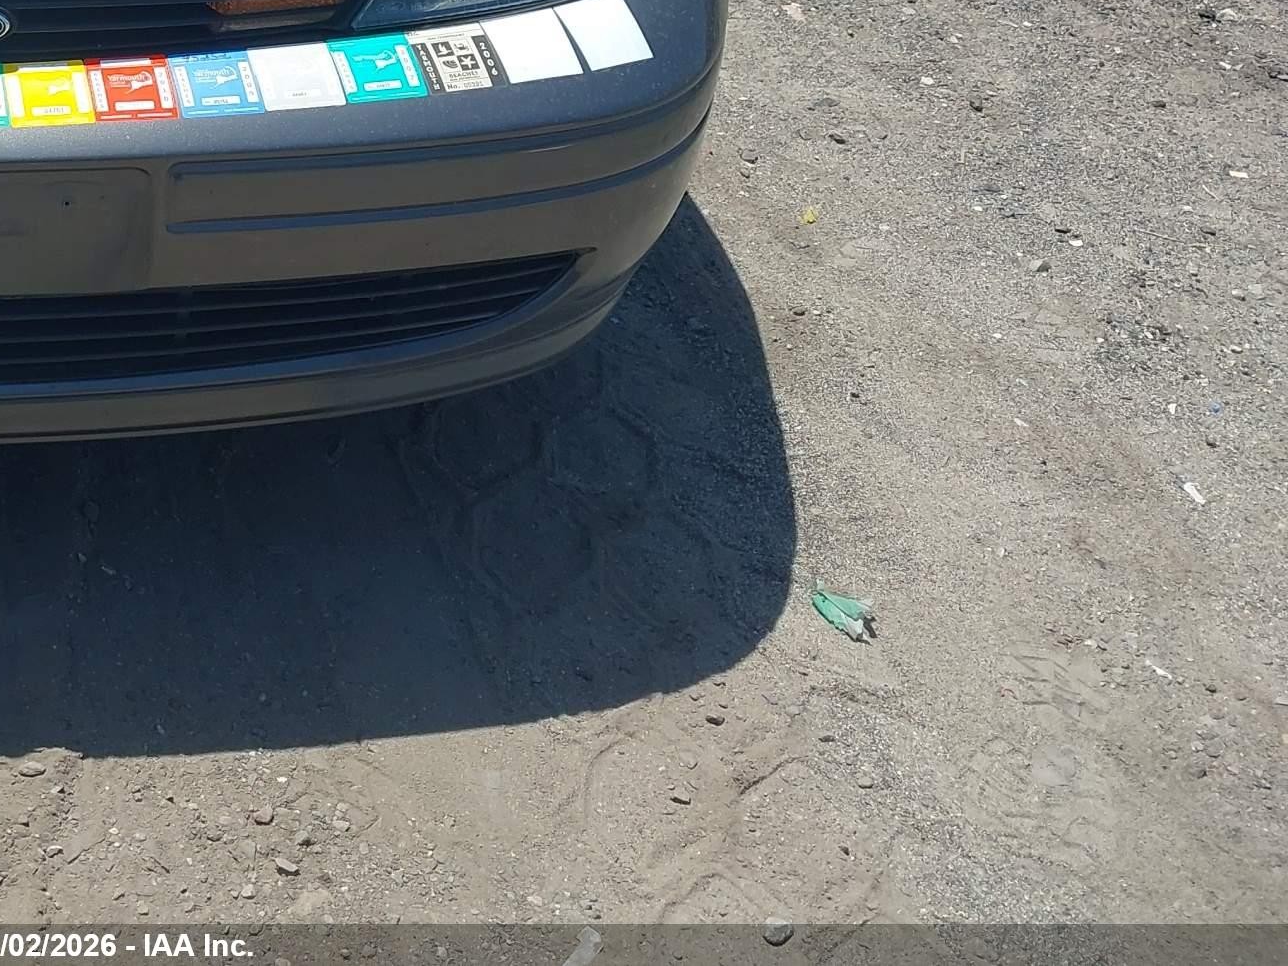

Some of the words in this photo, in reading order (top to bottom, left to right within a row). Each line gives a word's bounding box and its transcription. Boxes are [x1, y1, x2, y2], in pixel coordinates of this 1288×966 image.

[478, 42, 499, 77] 2006
[415, 44, 441, 91] YARMOUTH
[106, 73, 146, 84] Yarmouth
[193, 69, 230, 80] Yarmouth
[447, 82, 462, 91] No.
